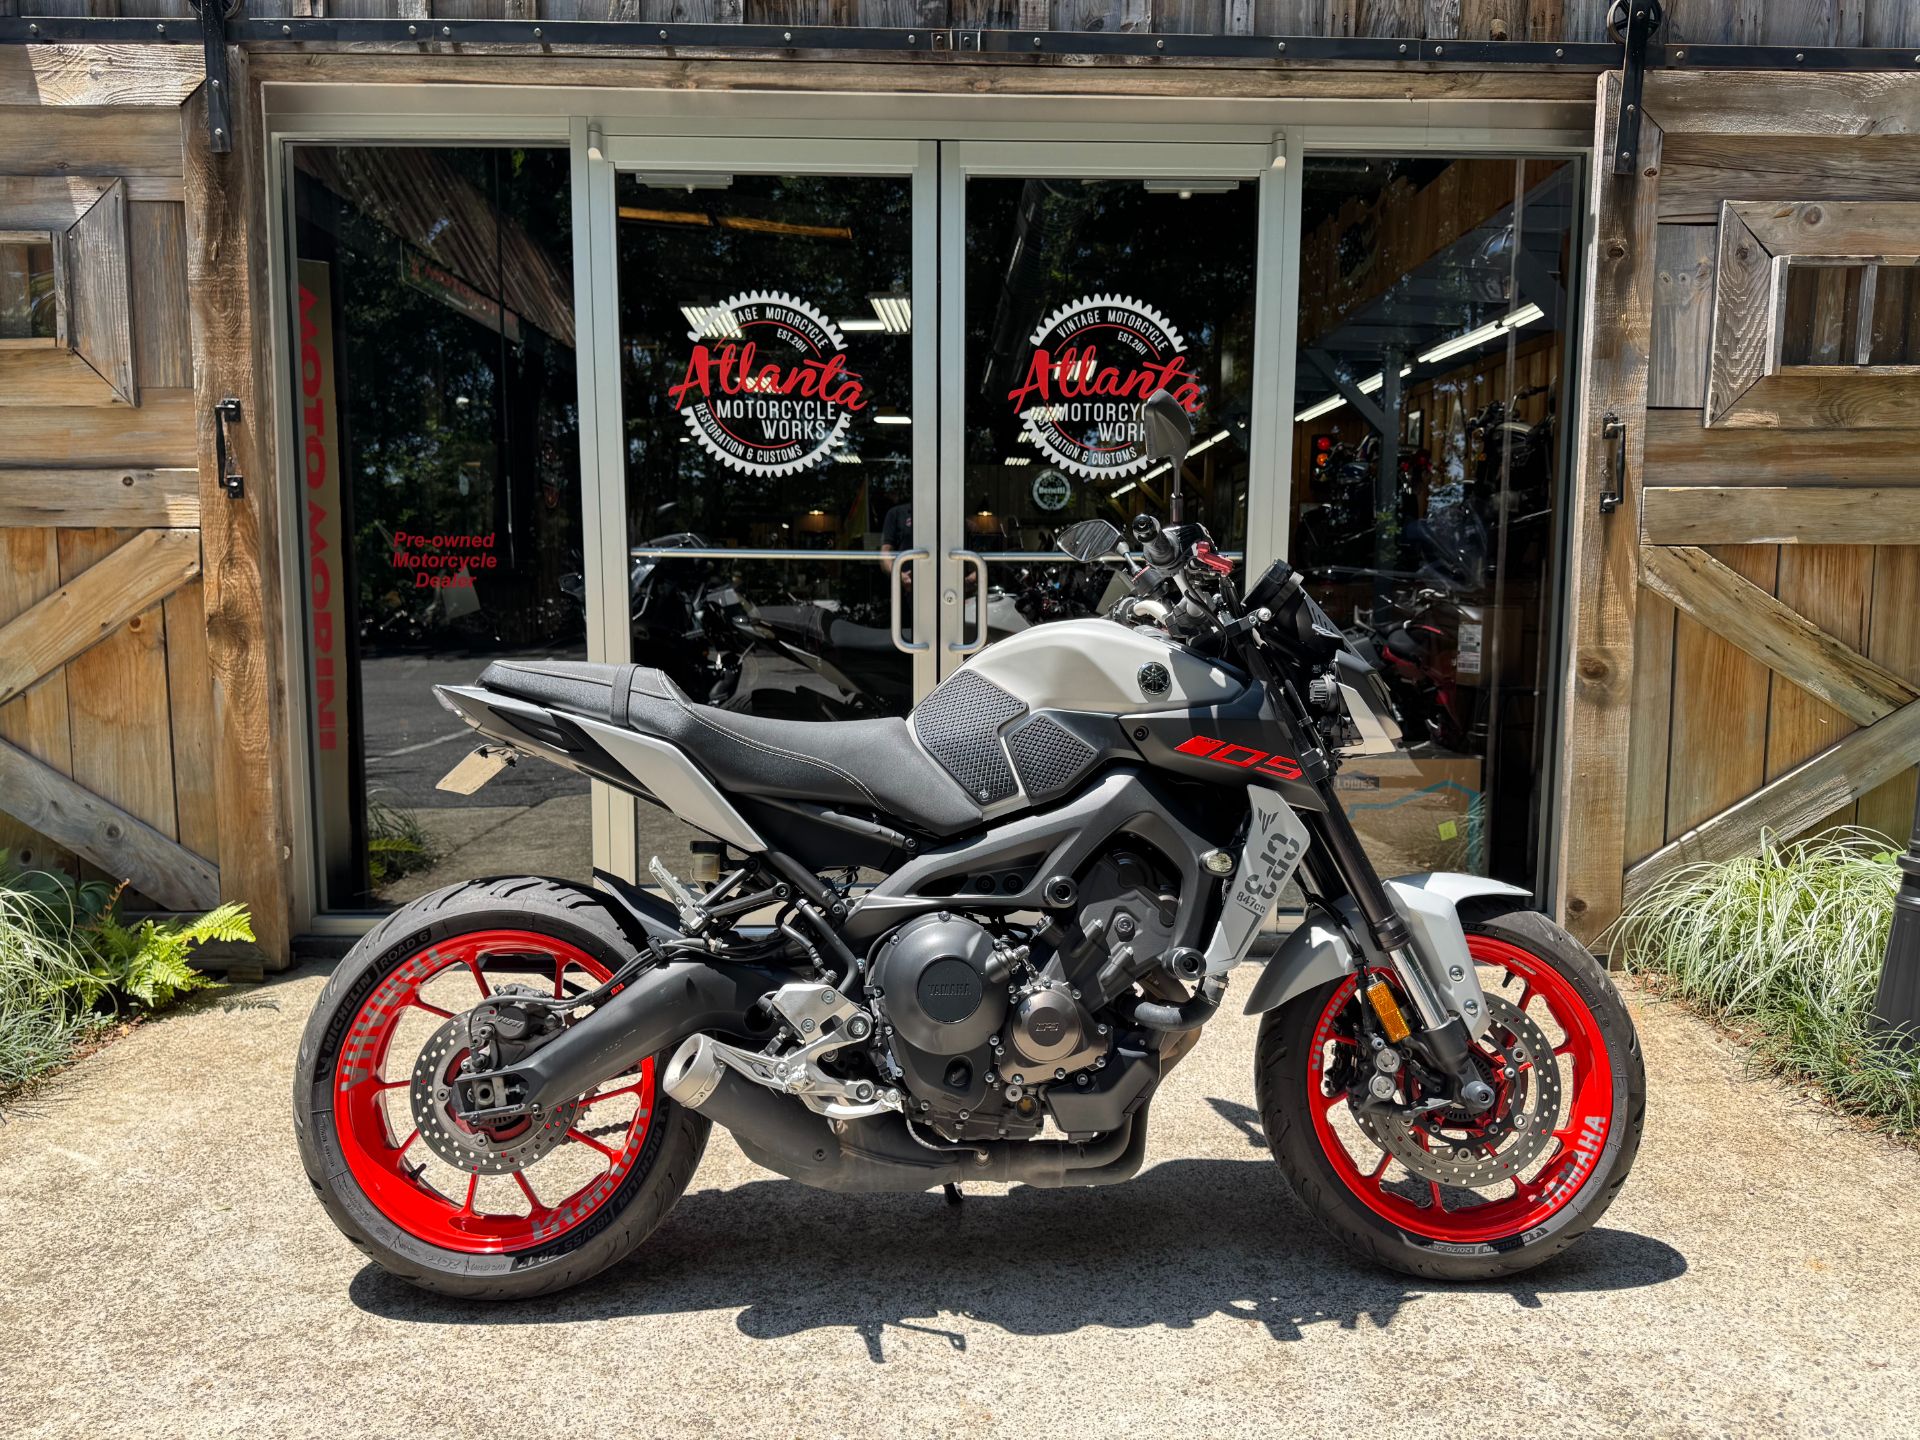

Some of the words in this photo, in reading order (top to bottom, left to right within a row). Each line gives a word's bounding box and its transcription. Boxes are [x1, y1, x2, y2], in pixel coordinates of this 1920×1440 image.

[765, 306, 828, 350] MOTORCYCLE
[1057, 310, 1100, 338] VINTAGE
[1108, 310, 1168, 352] MOTORCYCLE
[668, 341, 868, 411] Atlanta
[1008, 345, 1205, 414] Atlanta
[716, 400, 837, 420] MOTORCYCLE
[1054, 402, 1147, 422] MOTORCY
[695, 403, 744, 460] RESTORATION
[746, 449, 754, 460] &
[756, 444, 803, 463] CUSTOMS
[761, 419, 826, 440] WORKS
[1038, 418, 1081, 460] STORATION
[1092, 446, 1138, 465] CUSTOMS
[1098, 422, 1146, 442] WORK
[392, 531, 496, 548] Pre-owned
[392, 551, 498, 573] Motorcycle
[415, 572, 478, 589] Dealer
[1236, 890, 1267, 914] 847cc
[325, 973, 374, 1057] MICHELIN
[380, 937, 417, 970] ROAD
[418, 930, 431, 943] 6
[1535, 1115, 1607, 1209] YAMAHA
